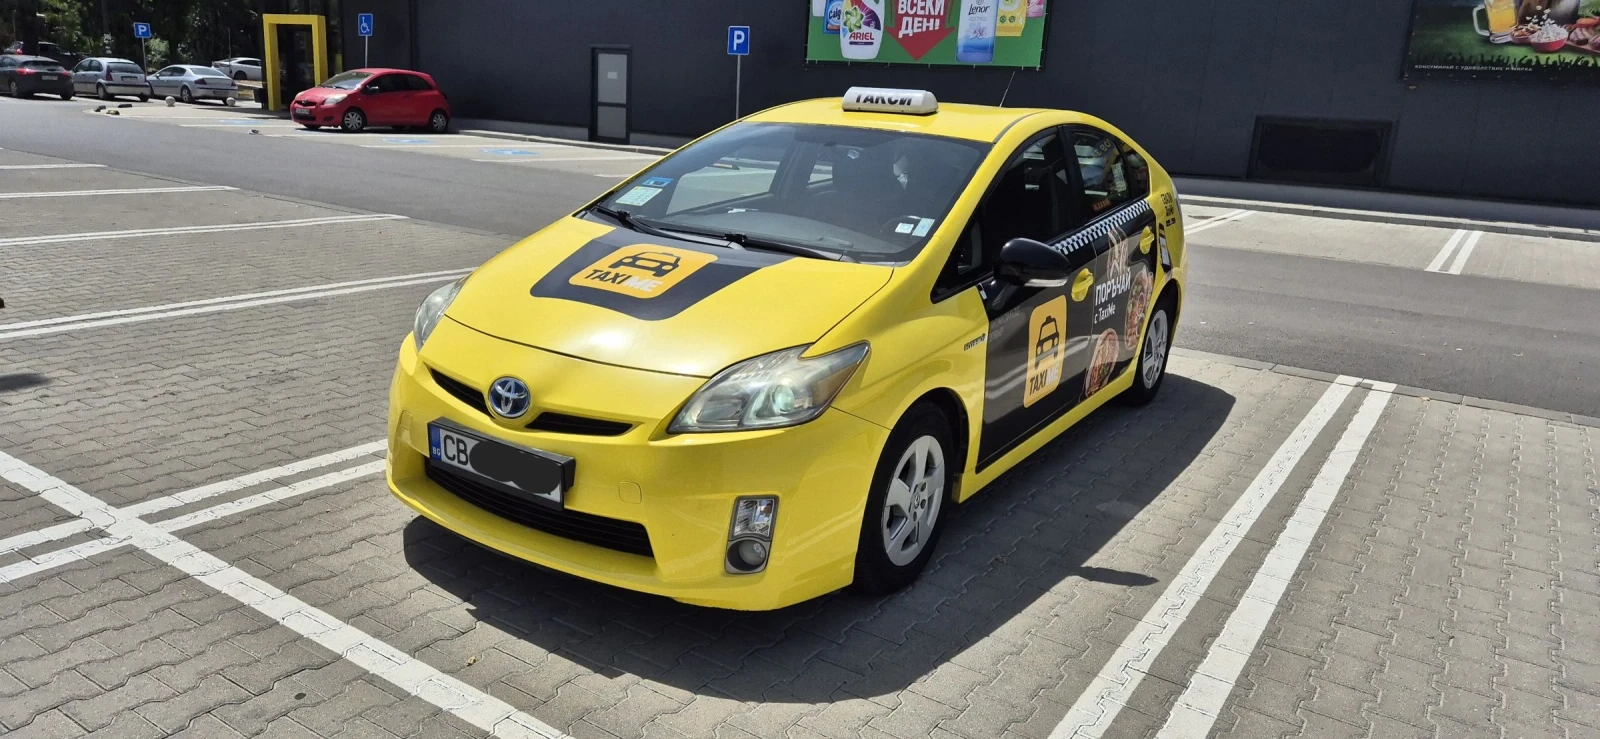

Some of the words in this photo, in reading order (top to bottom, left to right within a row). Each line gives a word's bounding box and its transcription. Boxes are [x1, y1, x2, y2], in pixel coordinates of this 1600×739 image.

[898, 0, 945, 15] ВСЕКИ
[968, 4, 990, 16] Lenor
[138, 25, 147, 36] P
[898, 15, 940, 38] ДЕН!
[734, 30, 745, 50] P
[849, 32, 874, 41] ARIEL
[855, 94, 912, 106] ТАКСИ
[1095, 266, 1131, 306] ПОРЪЧАЙ
[1099, 302, 1116, 322] TaxiMe
[432, 446, 441, 456] BG
